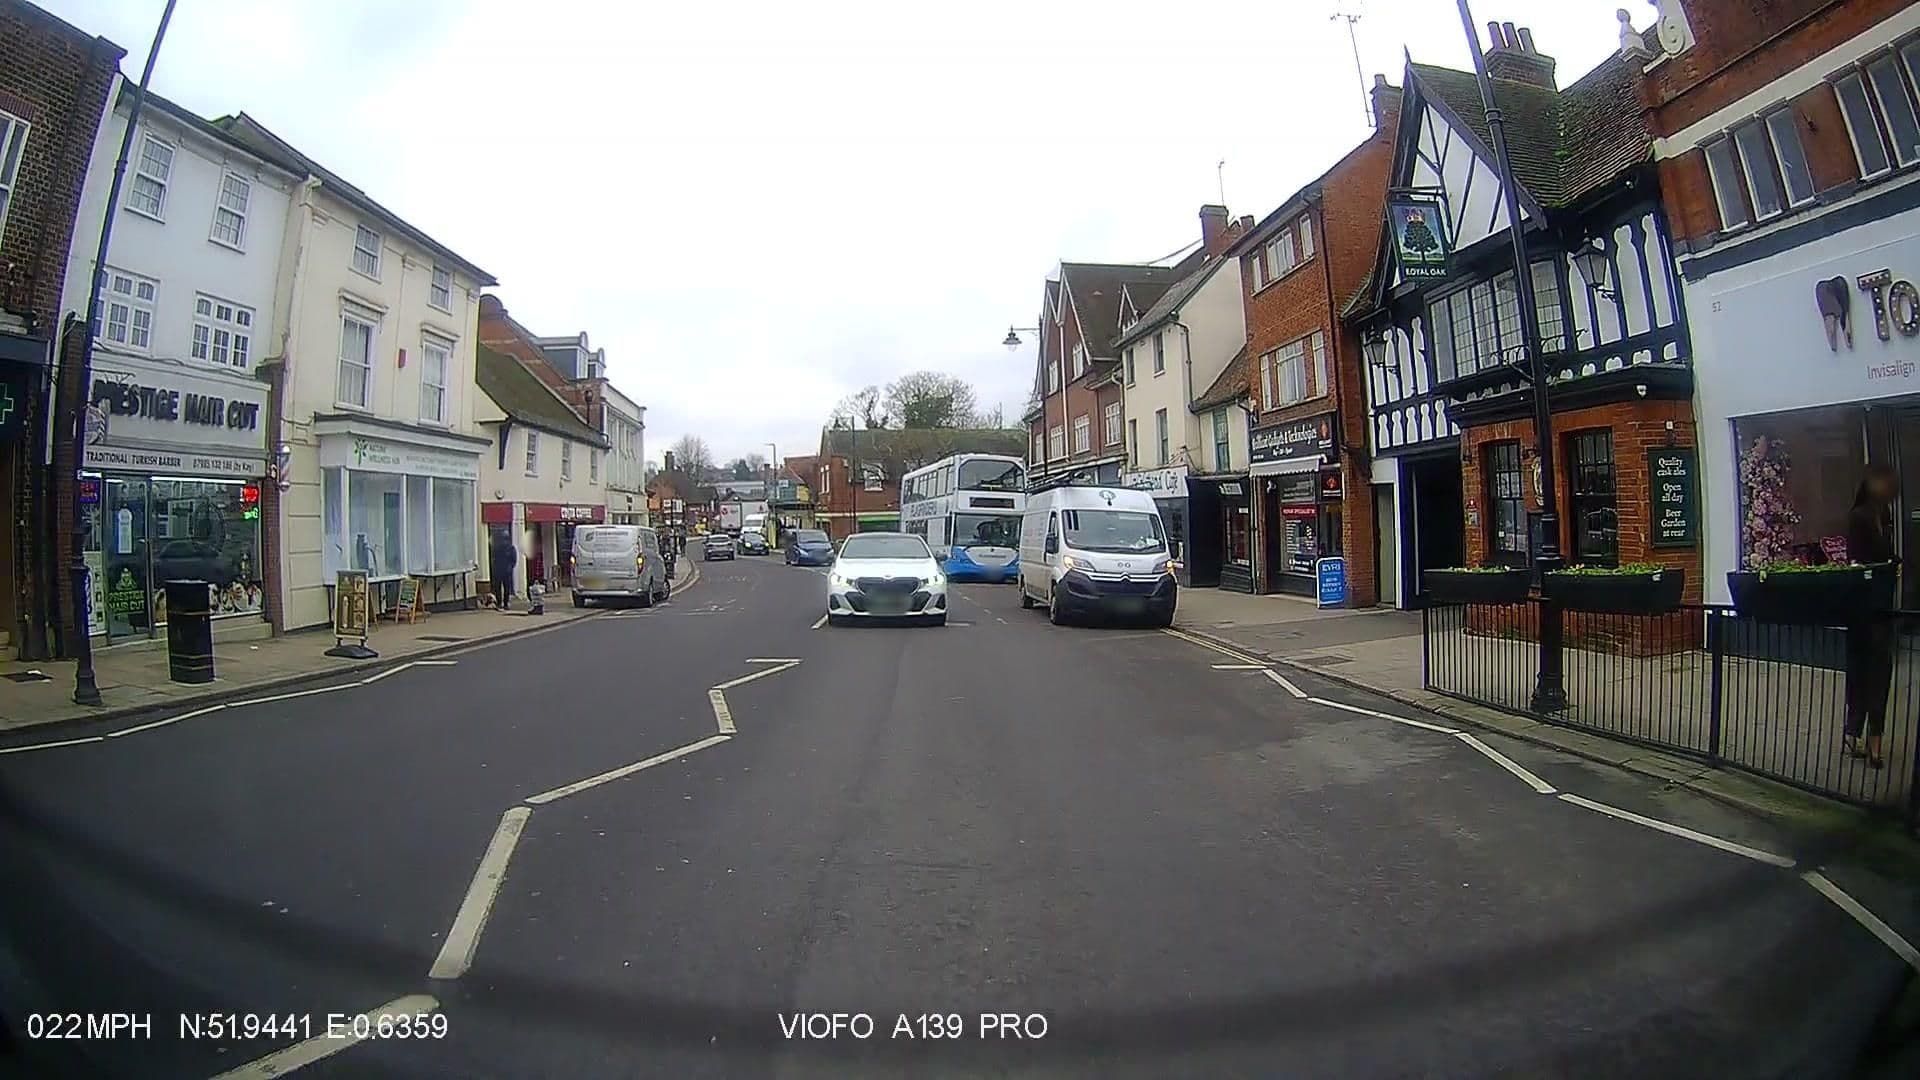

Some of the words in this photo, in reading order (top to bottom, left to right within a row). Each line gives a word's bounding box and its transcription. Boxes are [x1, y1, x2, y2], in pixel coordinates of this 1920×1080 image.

[1405, 267, 1429, 276] ROYAL
[1430, 267, 1446, 276] OAK
[1712, 301, 1721, 312] 52
[1866, 360, 1916, 380] Invisalign
[93, 379, 179, 421] PRESTIGE
[227, 400, 260, 431] CUT
[86, 451, 128, 464] TRADITIONAL
[132, 454, 158, 466] TURKISH
[158, 457, 181, 468] BARBER
[1658, 457, 1683, 468] Quality
[1657, 467, 1672, 476] cask
[1673, 467, 1686, 476] ales
[1663, 483, 1682, 493] Open
[1662, 493, 1670, 502] all
[1671, 493, 1684, 503] day
[1665, 509, 1682, 517] Beer
[1661, 518, 1686, 527] Garden
[1671, 529, 1685, 537] rear
[109, 591, 144, 601] PRESTIGE
[130, 601, 144, 611] CUT
